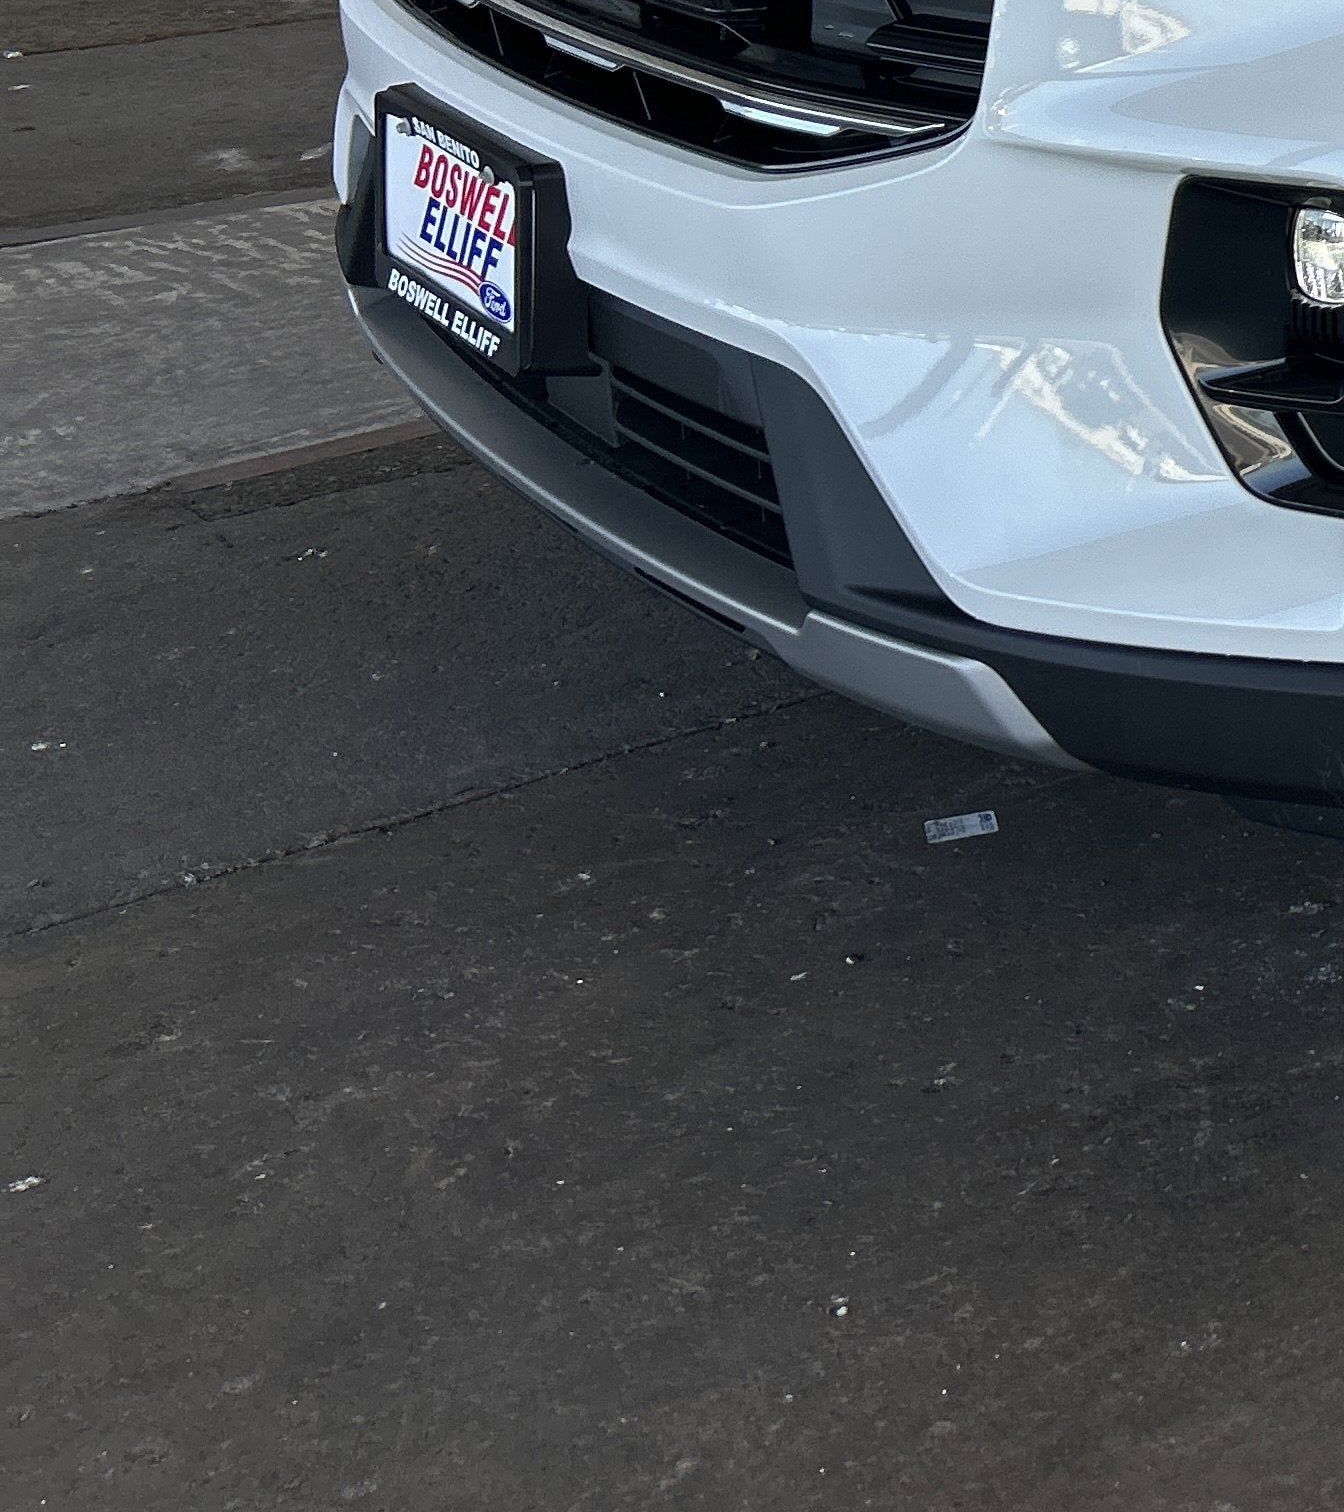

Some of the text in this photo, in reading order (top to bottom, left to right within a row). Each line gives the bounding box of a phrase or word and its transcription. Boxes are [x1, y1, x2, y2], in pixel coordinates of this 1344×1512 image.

[411, 116, 480, 169] SAN BENITO
[420, 196, 505, 283] ELLIFF
[387, 268, 501, 358] BOSWELL ELLIFF
[483, 286, 508, 318] Ford
